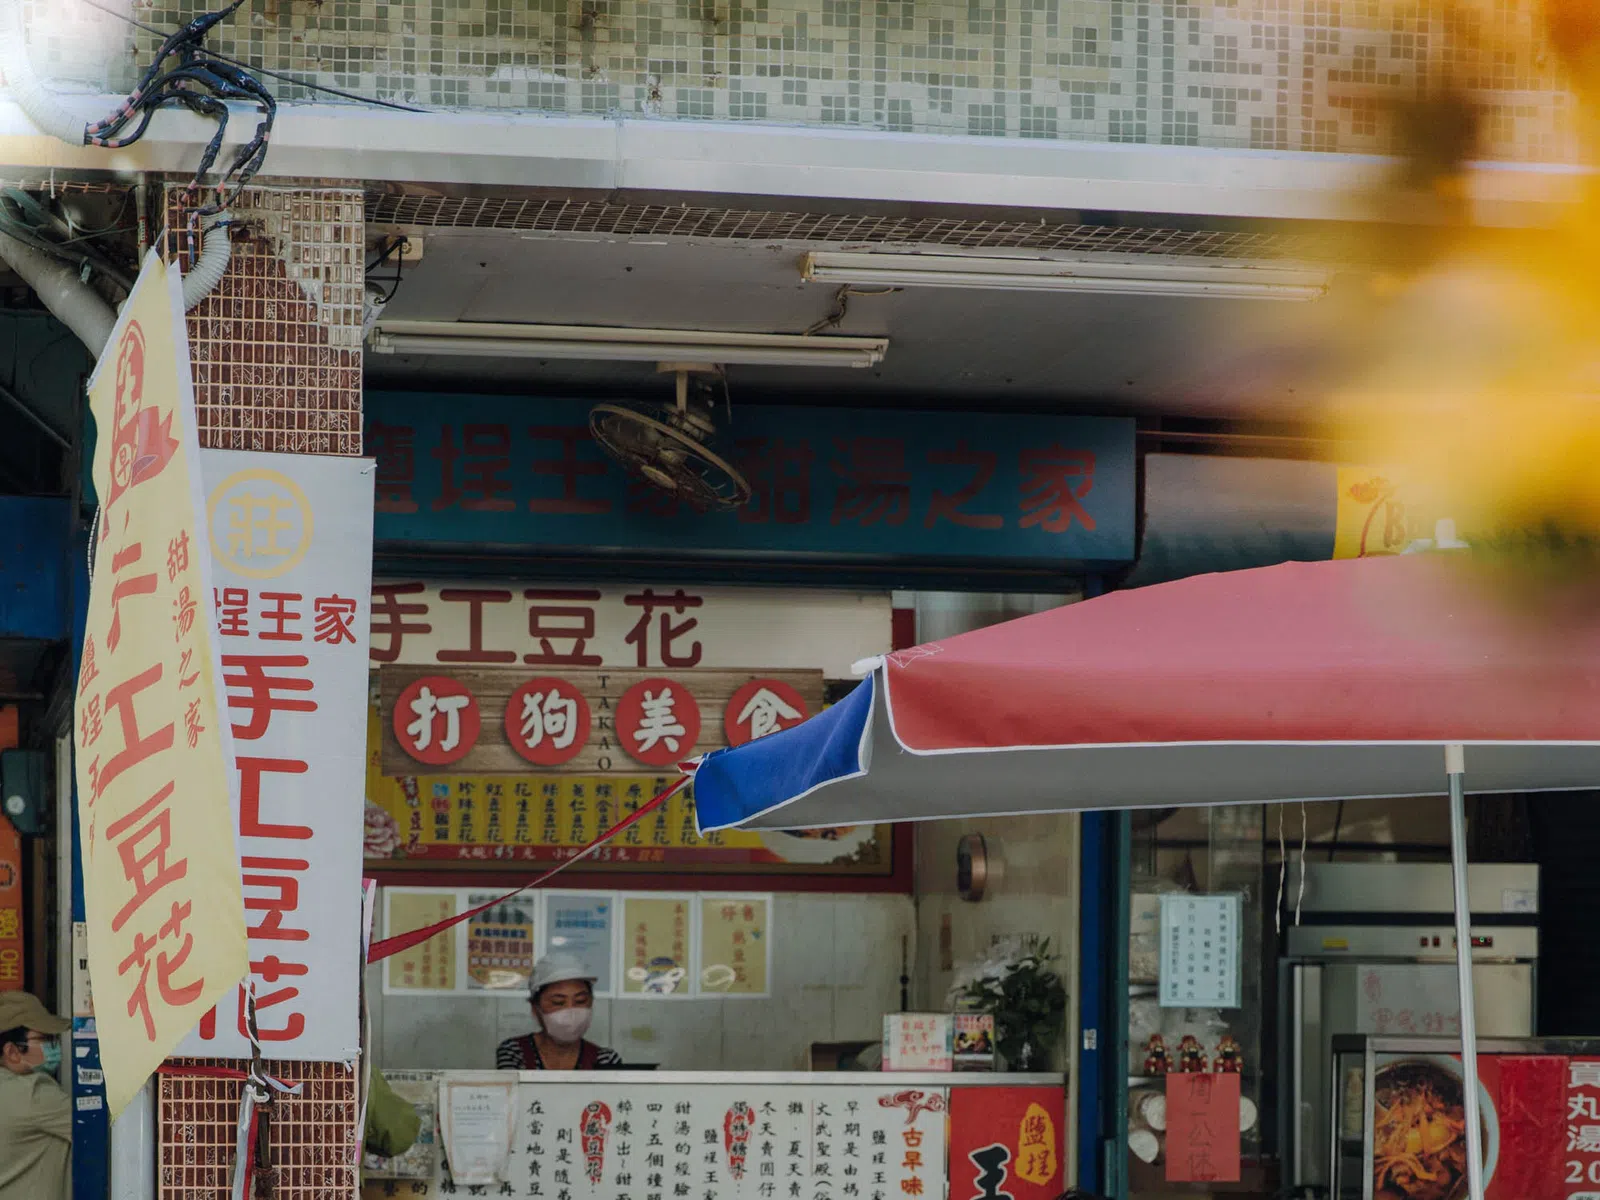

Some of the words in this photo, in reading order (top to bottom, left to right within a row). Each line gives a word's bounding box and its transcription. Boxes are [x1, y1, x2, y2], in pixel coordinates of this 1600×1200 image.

[167, 530, 206, 749] 甜湯之家
[369, 582, 704, 668] 手工豆花
[79, 633, 103, 862] 鹽埕王
[597, 675, 612, 772] TAKAO
[623, 783, 643, 844] 原味花
[1022, 1114, 1050, 1178] 鹽埕
